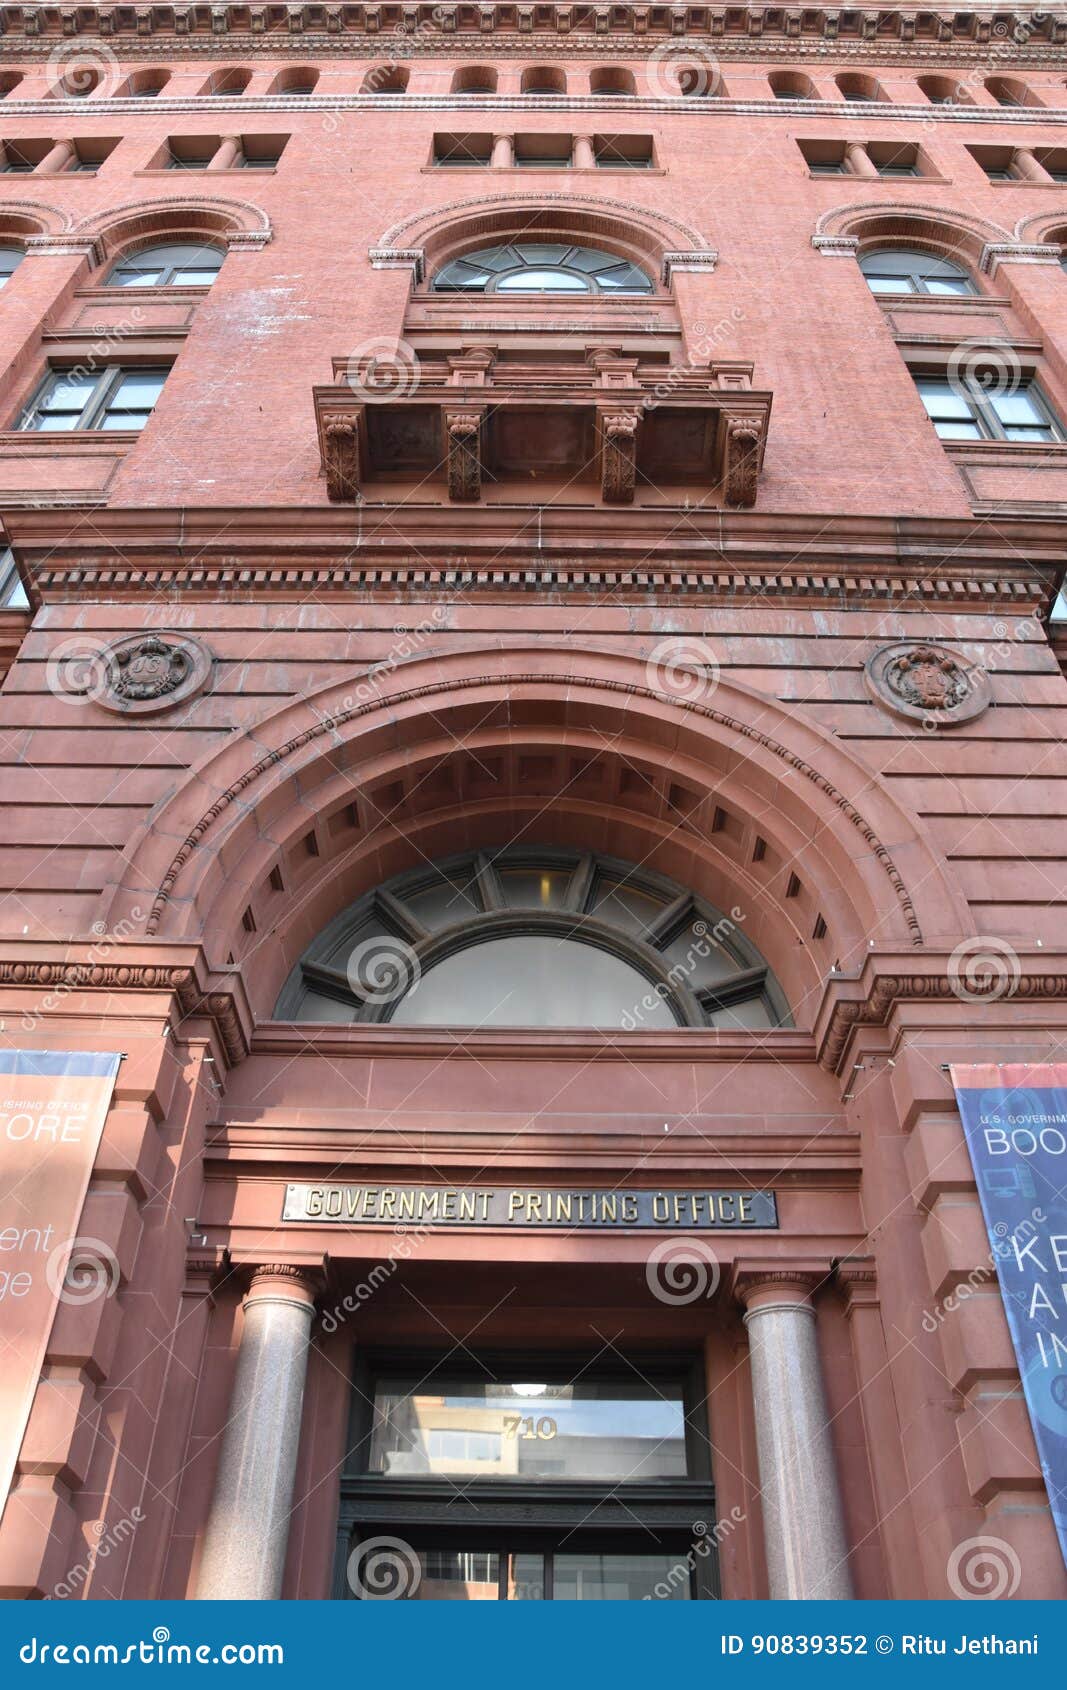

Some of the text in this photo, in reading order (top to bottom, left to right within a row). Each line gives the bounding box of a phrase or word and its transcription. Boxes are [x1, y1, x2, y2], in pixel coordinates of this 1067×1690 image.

[305, 1188, 756, 1224] GOVERNMENT PRINTING OFFICE
[503, 1415, 558, 1440] 710
